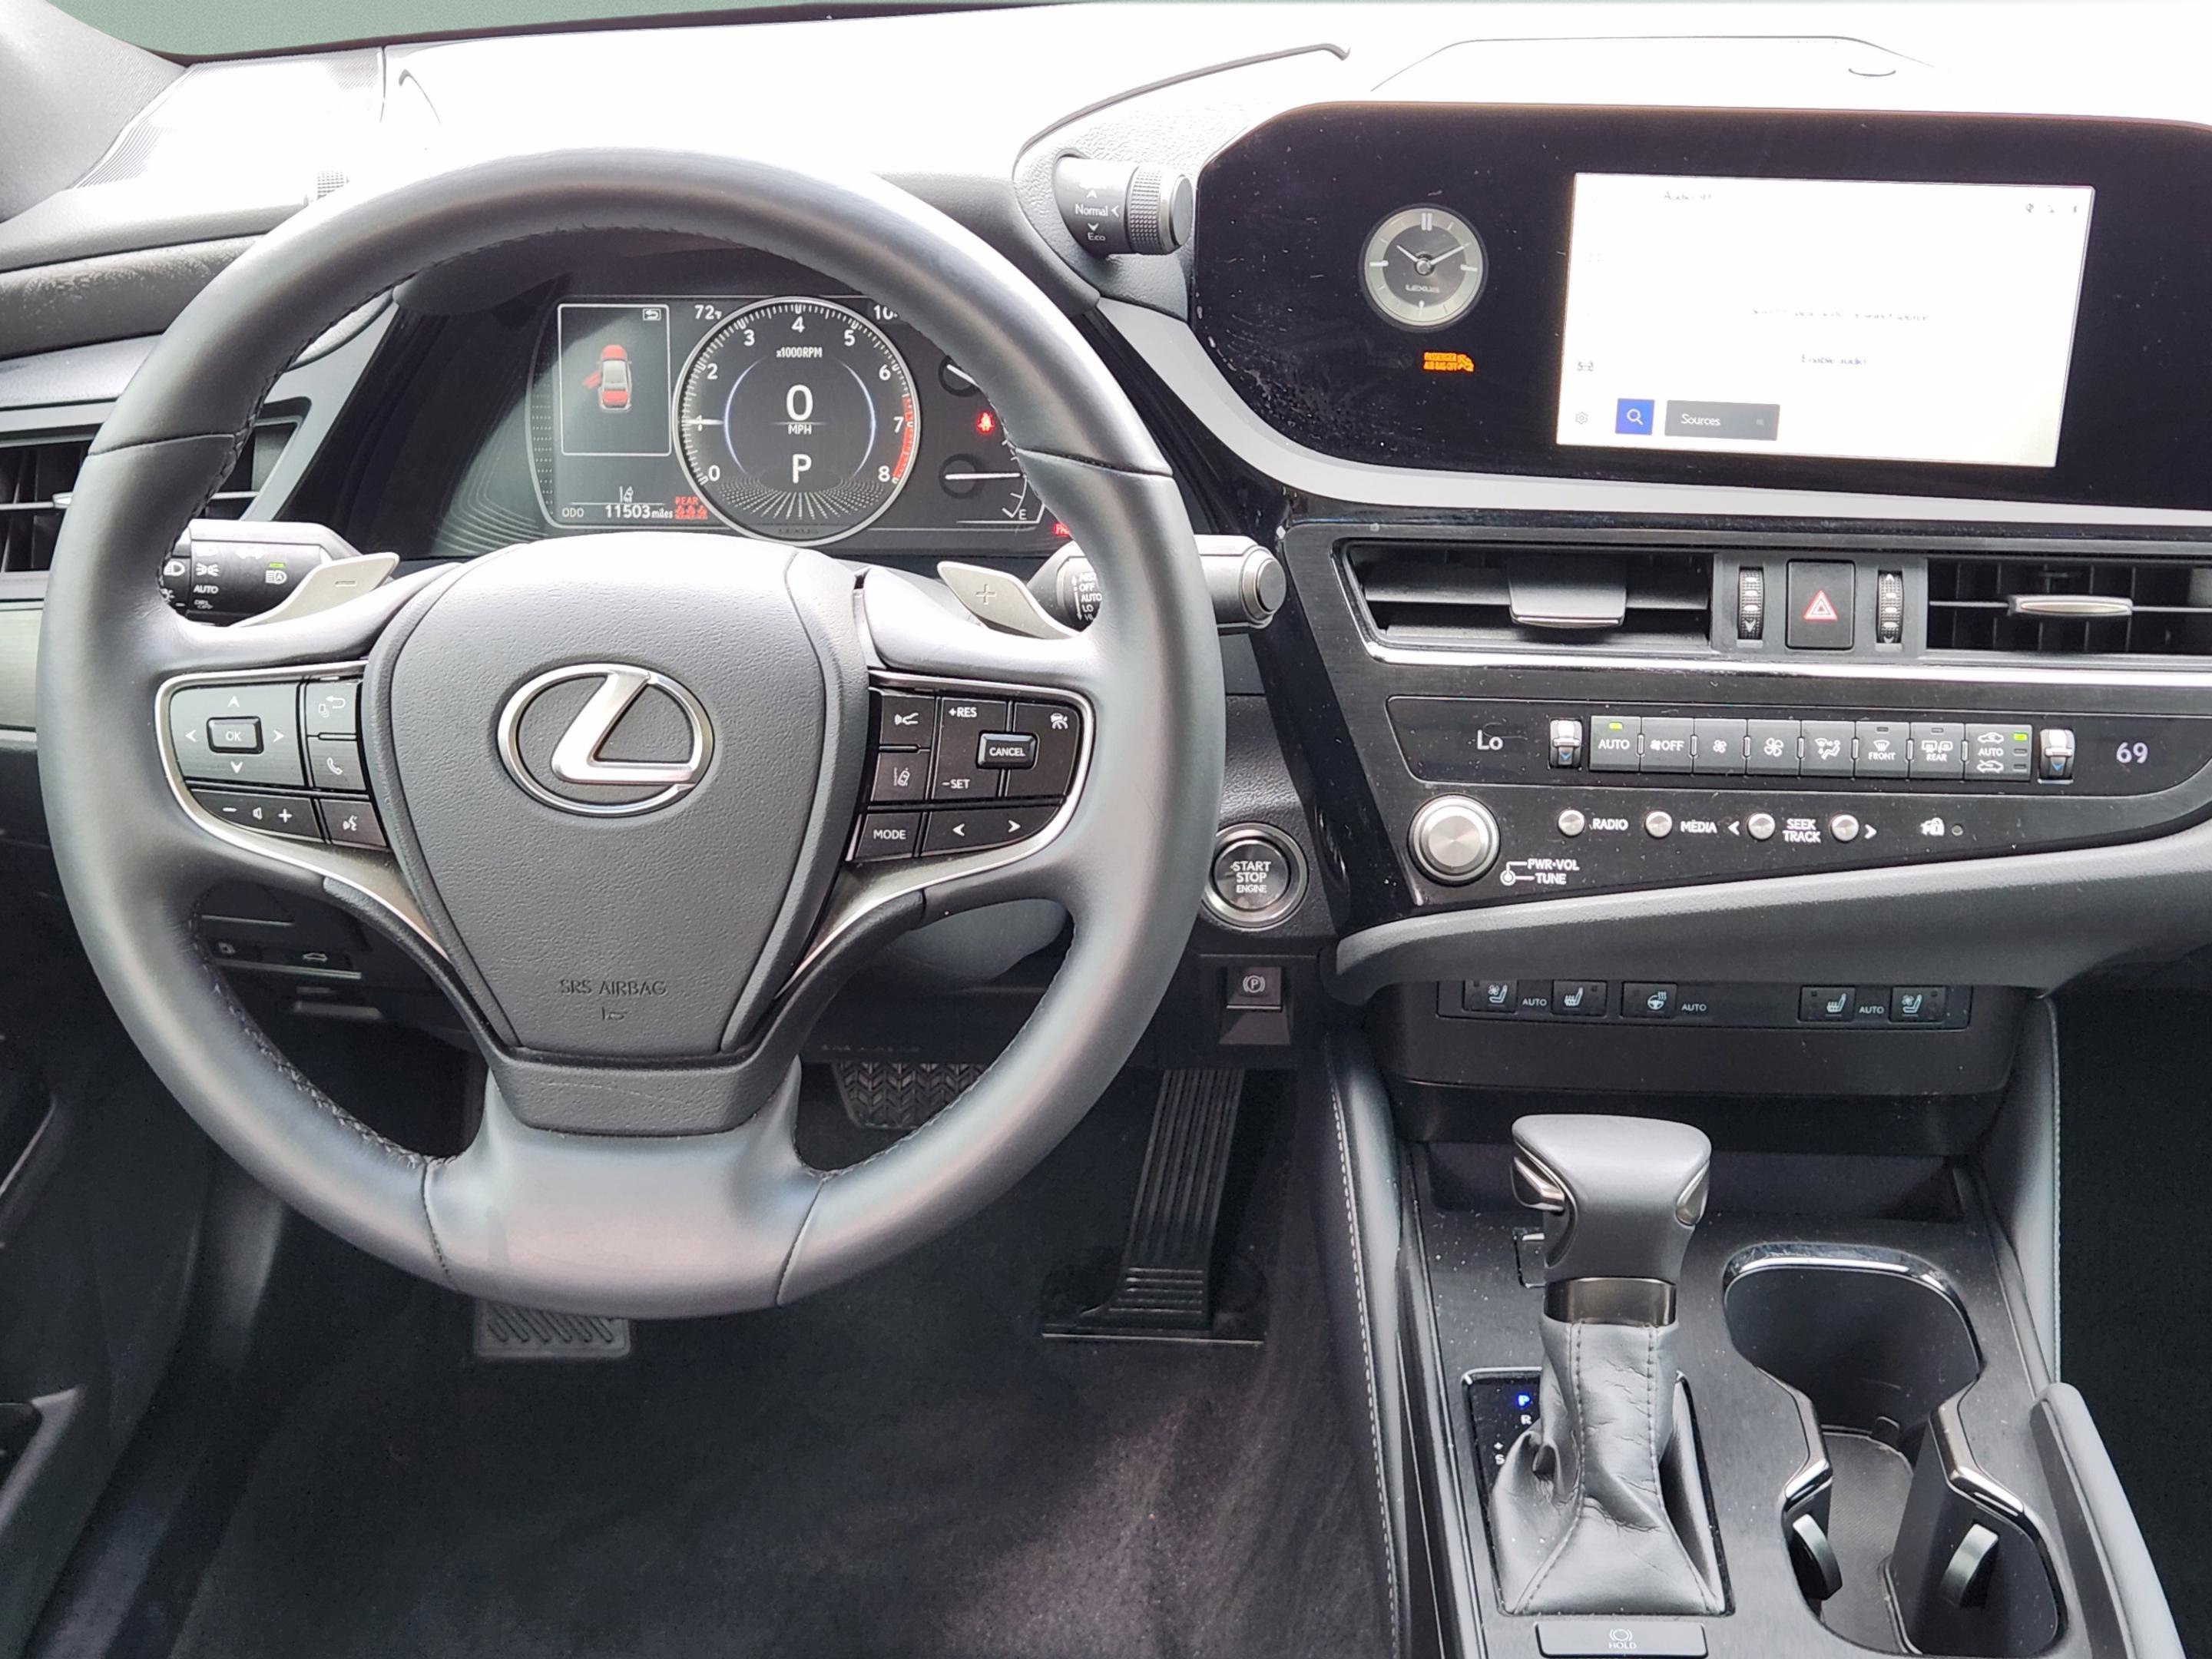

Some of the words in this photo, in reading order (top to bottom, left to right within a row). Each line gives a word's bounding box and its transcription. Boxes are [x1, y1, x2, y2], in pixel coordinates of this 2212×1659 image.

[1075, 204, 1108, 217] Normal
[1088, 233, 1105, 241] Eco
[792, 316, 805, 333] 4
[744, 329, 755, 346] 3
[844, 329, 856, 346] 5
[707, 363, 718, 379] 2
[879, 365, 892, 381] 6
[786, 384, 813, 422] 0
[893, 417, 904, 433] 7
[1681, 413, 1720, 426] Sources
[788, 424, 812, 435] MPH
[709, 465, 720, 482] 0
[793, 453, 812, 484] P
[878, 465, 891, 482] 8
[561, 508, 584, 518] ODO
[605, 505, 651, 518] 11503
[651, 508, 674, 518] miles
[1018, 509, 1027, 520] E
[193, 584, 220, 594] AUTO
[1079, 582, 1095, 592] OFF
[1081, 593, 1102, 603] AUTO
[1081, 604, 1094, 612] LO
[226, 731, 242, 742] OK
[1477, 729, 1503, 751] Lo
[1598, 740, 1630, 750] AUTO
[1661, 740, 1684, 752] OFF
[989, 747, 1025, 757] CANCEL
[1868, 752, 1896, 761] FRONT
[1978, 747, 2003, 757] AUTO
[2116, 741, 2148, 764] 69
[1926, 753, 1947, 763] REAR
[1593, 818, 1629, 831] RADIO
[1680, 820, 1717, 834] MEDIA
[1786, 819, 1816, 831] SEEK
[873, 830, 906, 840] MODE
[1783, 830, 1821, 843] TRACK
[1232, 861, 1271, 873] START
[1236, 872, 1267, 883] STOP
[1535, 873, 1567, 885] TUNE
[1236, 884, 1267, 893] ENGINE
[561, 979, 592, 995] SRS
[599, 980, 667, 996] AIRBAG
[1522, 998, 1547, 1007] AUTO
[1682, 1003, 1707, 1012] AUTO
[1859, 1006, 1884, 1015] AUTO
[1518, 1395, 1530, 1406] P
[1521, 1415, 1532, 1425] R
[1495, 1454, 1505, 1465] S
